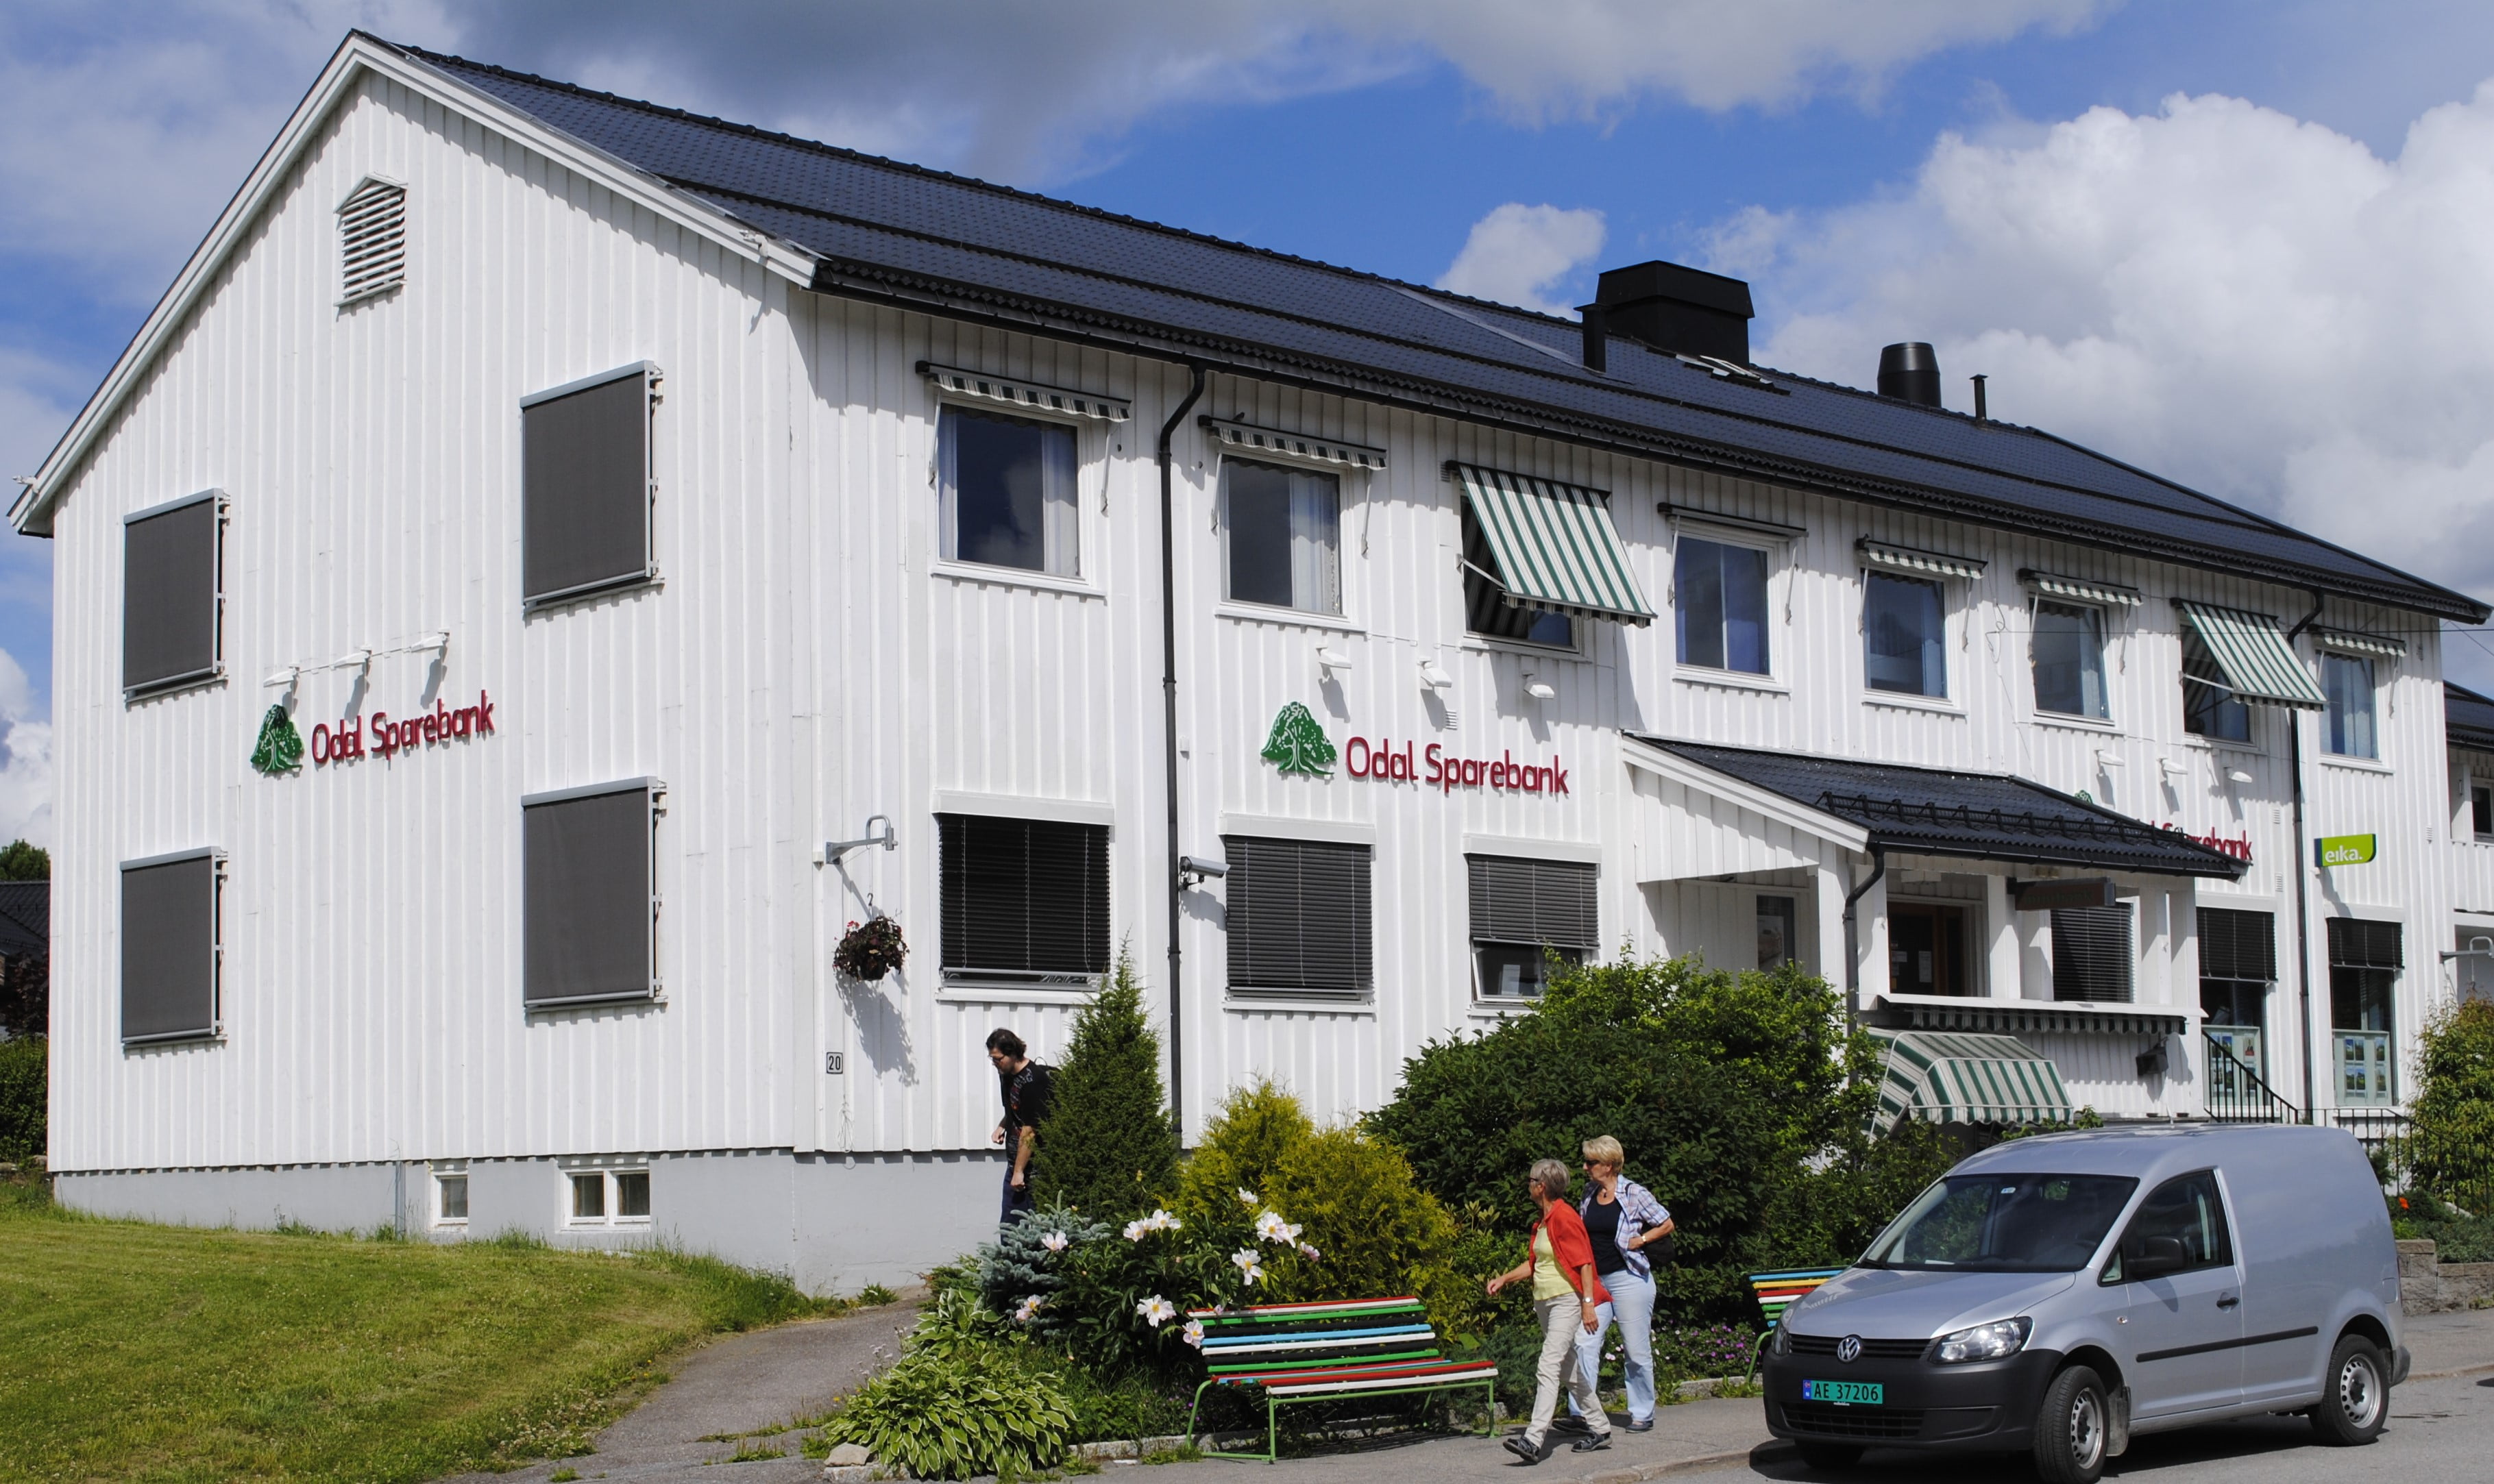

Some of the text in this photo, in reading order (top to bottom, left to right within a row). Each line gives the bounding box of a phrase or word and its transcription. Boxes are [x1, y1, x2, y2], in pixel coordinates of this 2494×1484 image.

[312, 689, 495, 763] Odal Sparebank
[1345, 737, 1569, 795] Odal Sparebank
[829, 1055, 841, 1070] 20
[1814, 1383, 1879, 1401] AE 37206
